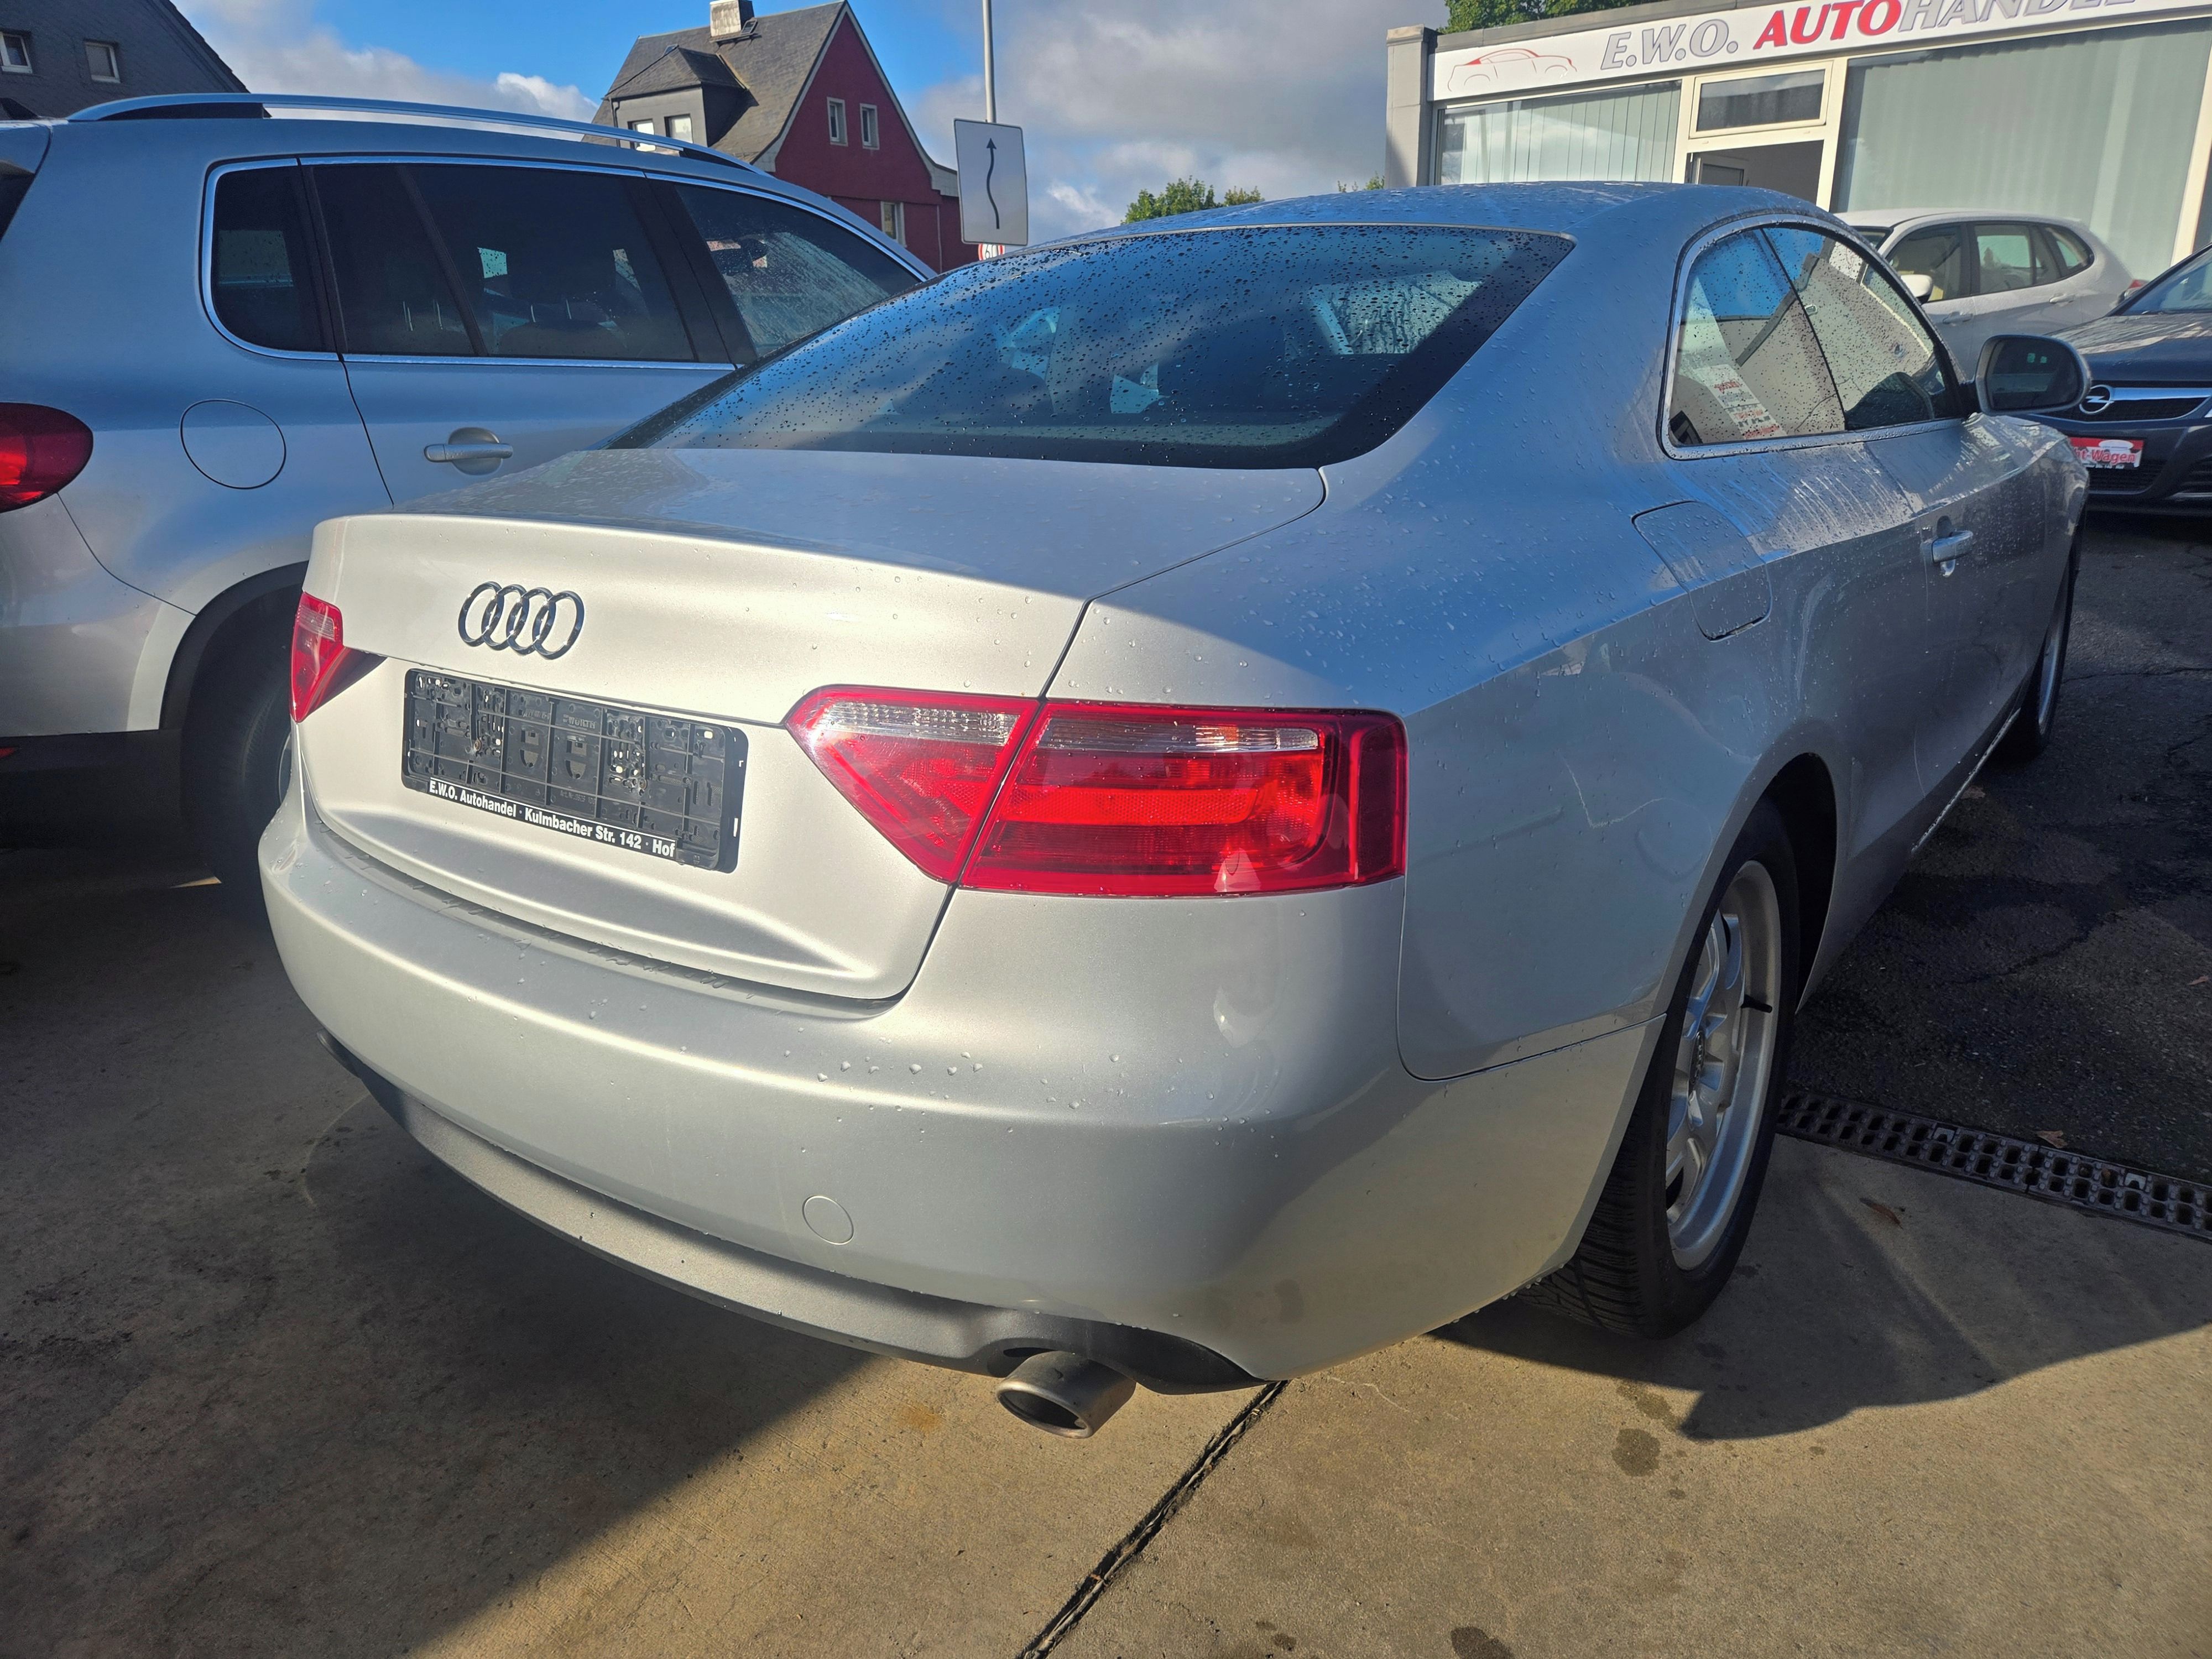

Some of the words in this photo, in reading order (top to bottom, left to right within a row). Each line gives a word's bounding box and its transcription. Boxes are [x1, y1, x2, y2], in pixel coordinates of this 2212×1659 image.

[1600, 18, 1739, 70] E.W.O.
[985, 243, 999, 259] 60
[429, 780, 458, 800] E.W.O.
[460, 790, 517, 817] Autohandel
[525, 807, 593, 837] Kulmbacher
[595, 825, 615, 843] Str.
[619, 831, 641, 849] 142
[652, 839, 675, 857] Hof
